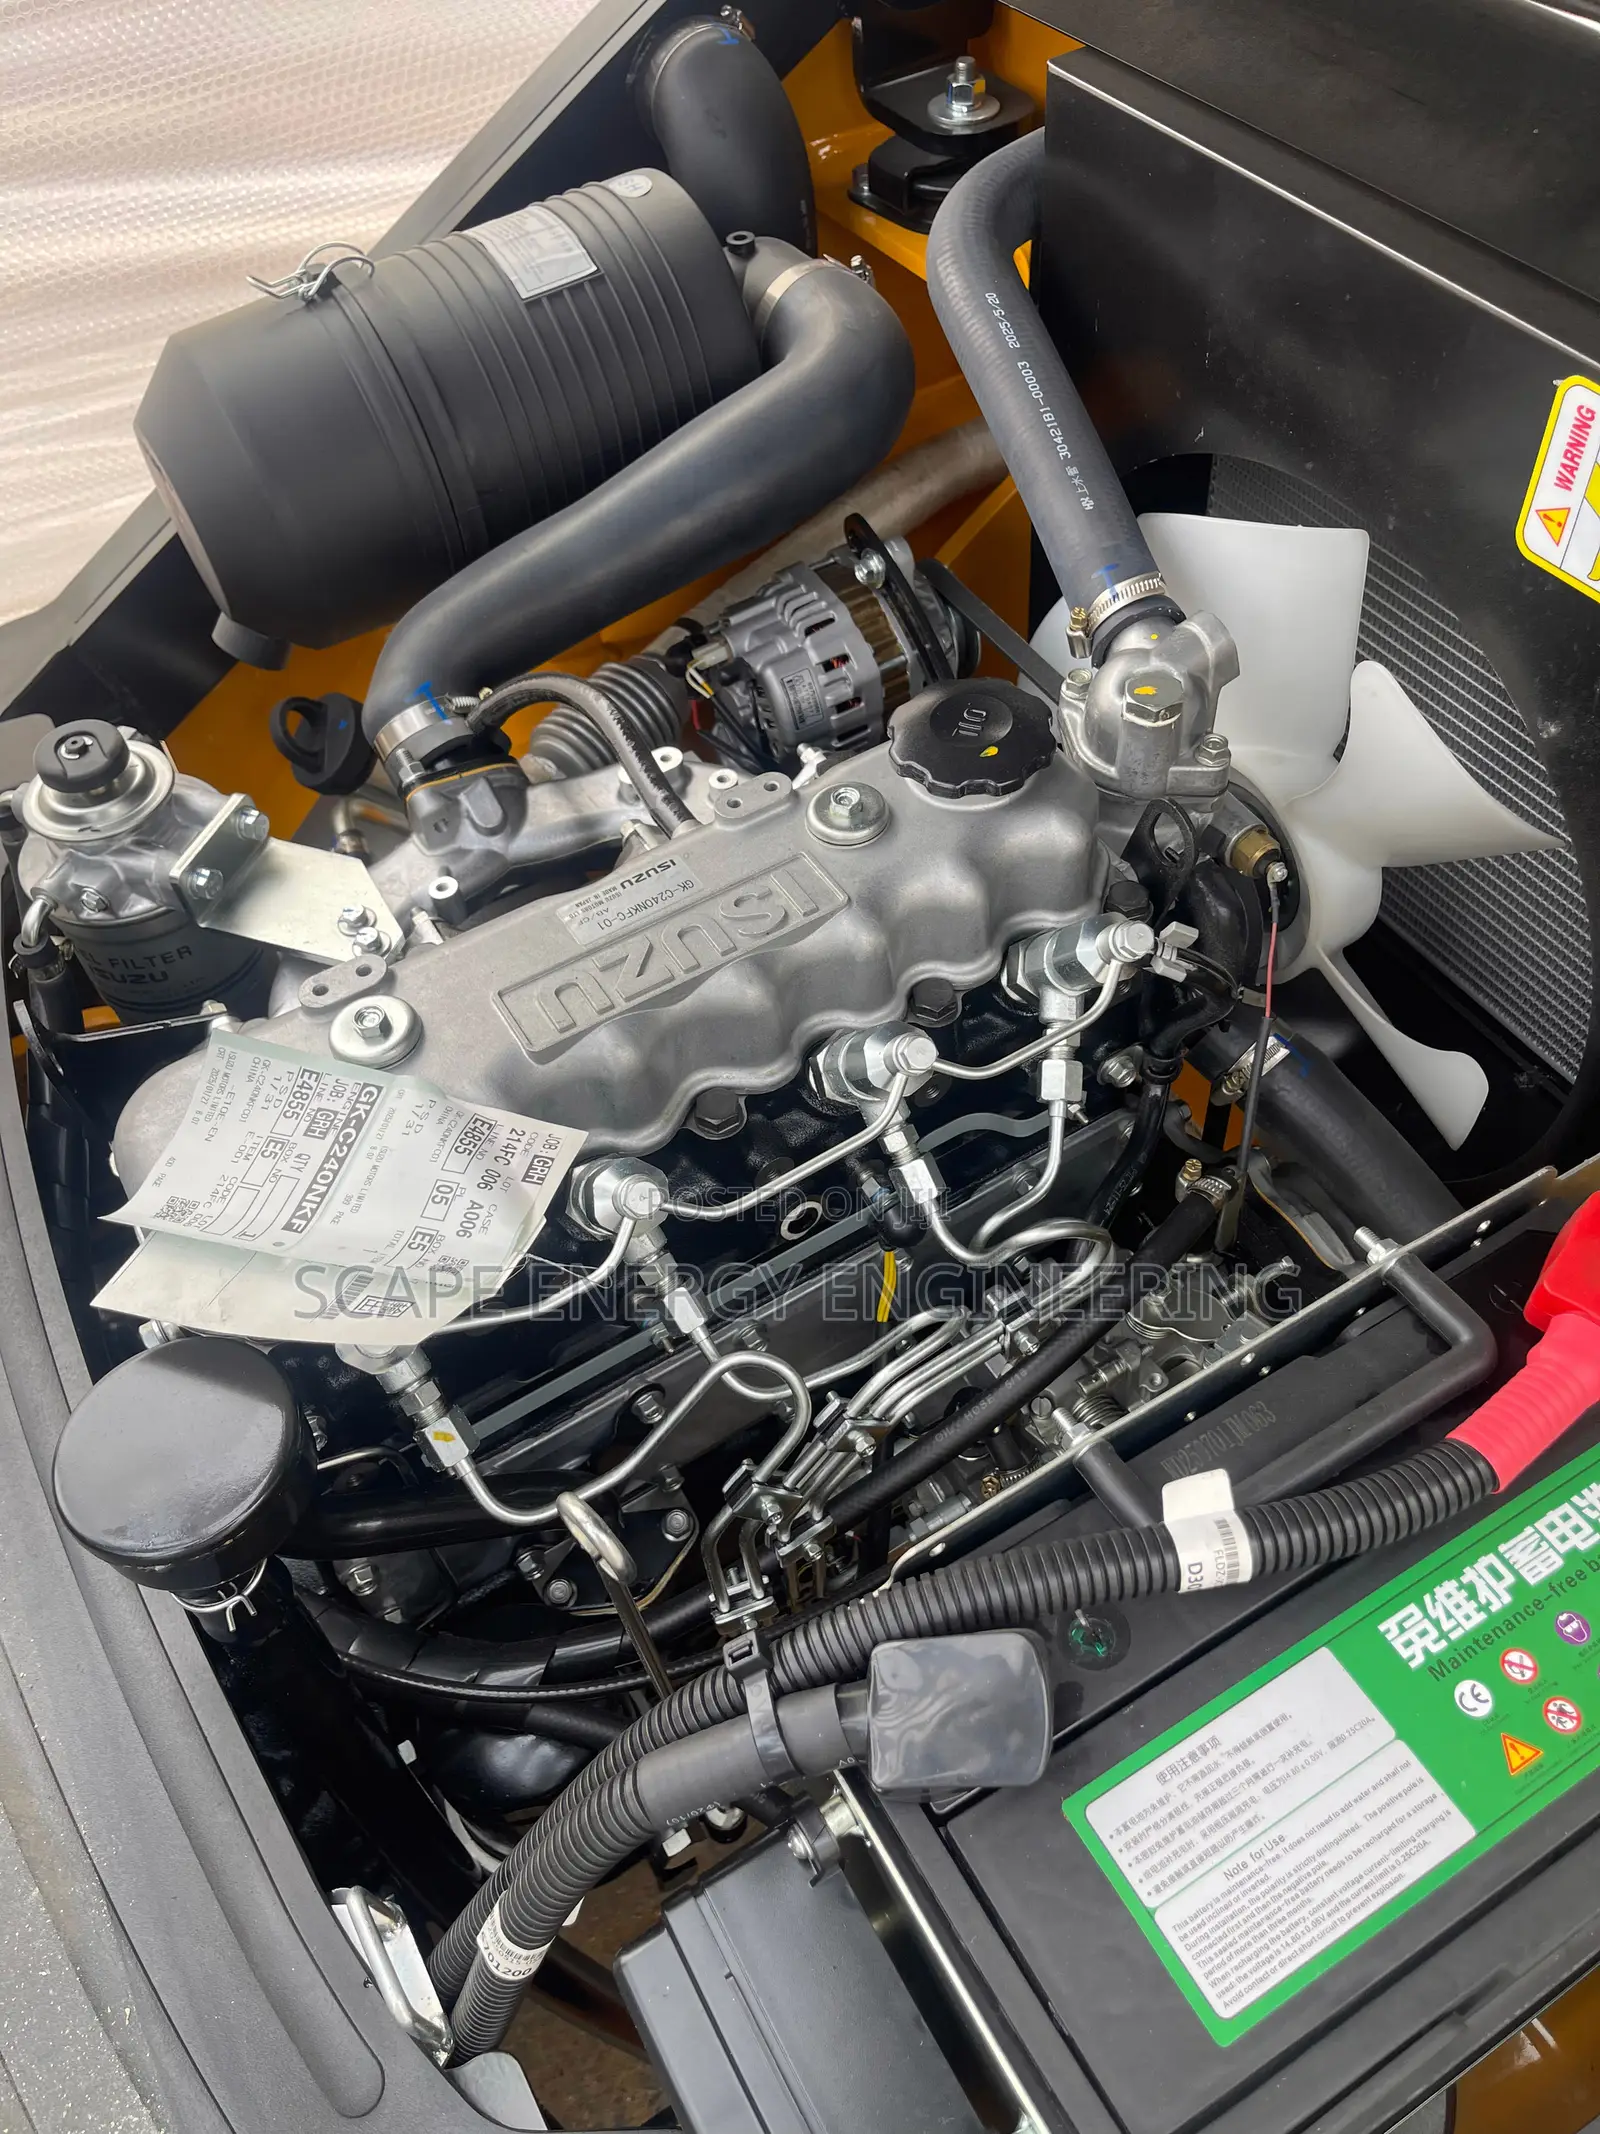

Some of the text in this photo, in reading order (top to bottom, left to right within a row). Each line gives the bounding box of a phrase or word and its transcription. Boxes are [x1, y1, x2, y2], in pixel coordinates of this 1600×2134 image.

[984, 289, 1021, 351] 2025/5/20
[1016, 358, 1072, 462] 30421B1-00003
[1551, 403, 1597, 491] WARNING
[952, 708, 987, 737] OIL
[601, 885, 617, 895] MADE
[618, 858, 677, 889] ISUZU
[574, 896, 591, 908] JAPAN
[594, 877, 696, 930] GK-C240NKFC-01
[89, 966, 169, 985] ISUZU
[108, 945, 193, 971] FILTER
[536, 869, 818, 1034] ISUZU
[196, 1067, 222, 1105] 2025/01/27
[202, 1050, 239, 1123] ISUZU MOTORS LIMITED
[242, 1055, 263, 1084] CHINA
[259, 1074, 282, 1111] 1/31
[259, 1065, 320, 1163] E4855 E5
[267, 1071, 332, 1184] LINE NO BOX NO
[328, 1080, 361, 1137] ENGINE
[400, 1101, 424, 1137] 1/31
[435, 1103, 453, 1127] CHINA
[230, 1128, 255, 1165] E-001
[237, 1077, 349, 1243] JOB: GRH QTY 1
[242, 1133, 263, 1163] ITEM
[288, 1080, 379, 1236] GK-C240NKF
[453, 1113, 493, 1161] E4855
[524, 1131, 562, 1187] JOB: GRH
[202, 1171, 229, 1211] 214FC
[216, 1174, 238, 1206] CODE
[348, 1187, 368, 1214] LIMITED
[362, 1163, 380, 1187] MOTORS
[428, 1121, 503, 1256] LINE NO PL BOX
[429, 1181, 454, 1208] 05
[453, 1124, 526, 1241] 214FC 006 A006
[476, 1130, 538, 1236] CODE LOT CASE
[383, 1226, 405, 1254] TOTAL
[407, 1226, 434, 1255] E5
[962, 1393, 998, 1422] HOSE
[1427, 1567, 1588, 1682] Maintenance-free
[1154, 1734, 1222, 1786] 使用注意事项
[1171, 1917, 1189, 1933] This
[1187, 1899, 1215, 1923] battery
[1286, 1834, 1305, 1851] does
[1303, 1825, 1317, 1838] not
[1314, 1814, 1334, 1831] need
[1338, 1800, 1353, 1814] add
[1350, 1787, 1372, 1804] water
[1369, 1777, 1384, 1791] and
[1382, 1766, 1401, 1782] shall
[1397, 1758, 1411, 1771] not
[1184, 1930, 1210, 1953] During
[1207, 1901, 1250, 1936] installation,
[1247, 1893, 1261, 1906] the
[1259, 1874, 1287, 1899] polarity
[1291, 1853, 1317, 1875] strictly
[1363, 1809, 1378, 1822] The
[1376, 1790, 1404, 1814] positive
[1401, 1780, 1419, 1796] pole
[1222, 1831, 1286, 1881] Note for Use
[1187, 1918, 1206, 1935] used
[1204, 1898, 1234, 1923] inclined
[1239, 1871, 1272, 1898] inverted.
[1196, 1953, 1214, 1970] This
[1212, 1936, 1238, 1958] sealed
[1236, 1891, 1300, 1940] maintenance-free
[1298, 1873, 1325, 1897] battery
[1323, 1858, 1346, 1877] needs
[1360, 1821, 1398, 1851] recharged
[1410, 1791, 1438, 1815] storage
[1208, 1813, 1446, 1988] When recharging the battery, constant voltage current-limiting charging
[1190, 1930, 1228, 1961] connected
[1226, 1920, 1243, 1935] first
[1240, 1910, 1256, 1924] and
[1254, 1899, 1272, 1915] then
[1269, 1890, 1283, 1903] the
[1281, 1869, 1313, 1896] negative
[1234, 1970, 1249, 1984] the
[1246, 1951, 1276, 1976] voltage
[1324, 1904, 1340, 1918] and
[1337, 1894, 1353, 1908] the
[1350, 1877, 1376, 1899] current
[1373, 1867, 1390, 1882] limit
[1202, 1957, 1227, 1980] period
[1232, 1939, 1253, 1956] more
[1251, 1927, 1268, 1943] than
[1266, 1913, 1287, 1931] three
[1222, 1989, 1244, 2009] Avoid
[1242, 1969, 1271, 1994] contact
[1276, 1948, 1300, 1969] direct
[1297, 1935, 1318, 1953] short
[1315, 1920, 1338, 1940] circuit
[1344, 1895, 1373, 1920] prevent
